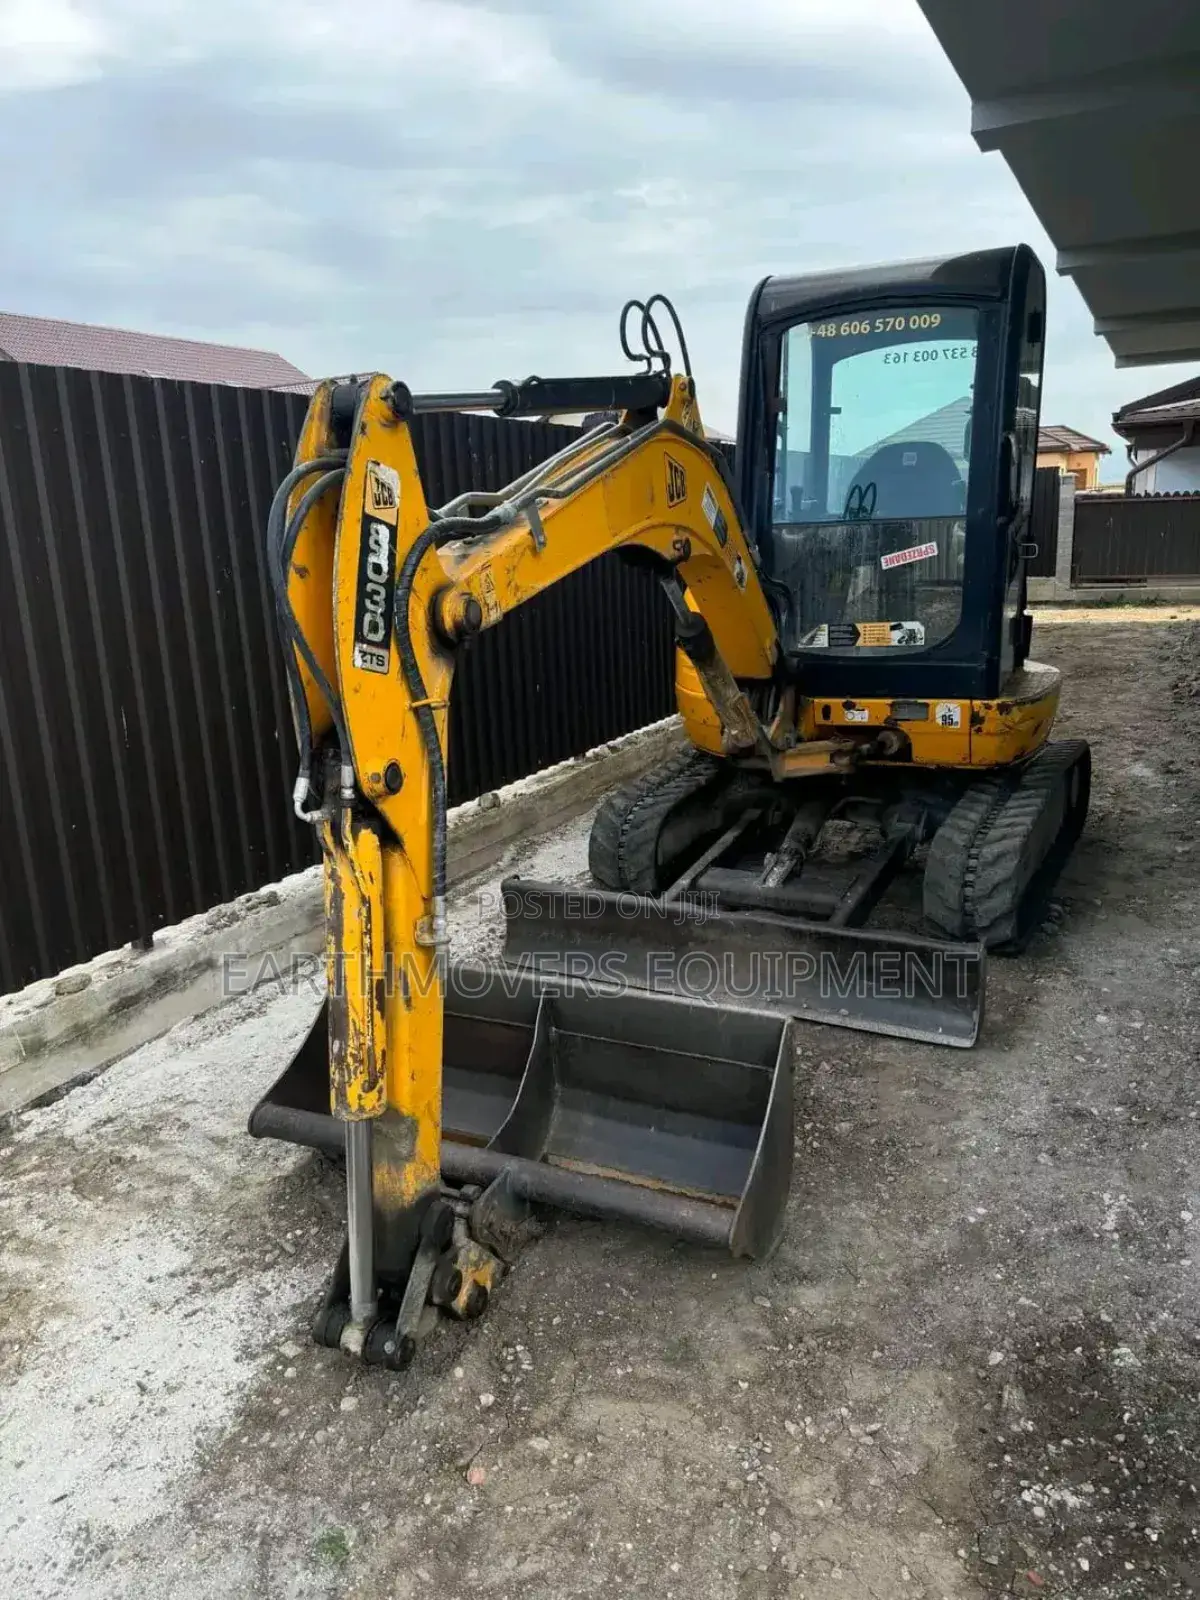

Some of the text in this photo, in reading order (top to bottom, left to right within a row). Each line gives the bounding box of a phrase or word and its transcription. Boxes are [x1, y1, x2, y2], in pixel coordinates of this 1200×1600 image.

[840, 320, 870, 336] 606
[874, 317, 905, 332] 570
[909, 313, 941, 329] 009
[373, 476, 396, 507] JCB
[668, 459, 686, 503] JCB
[941, 714, 953, 726] 95
